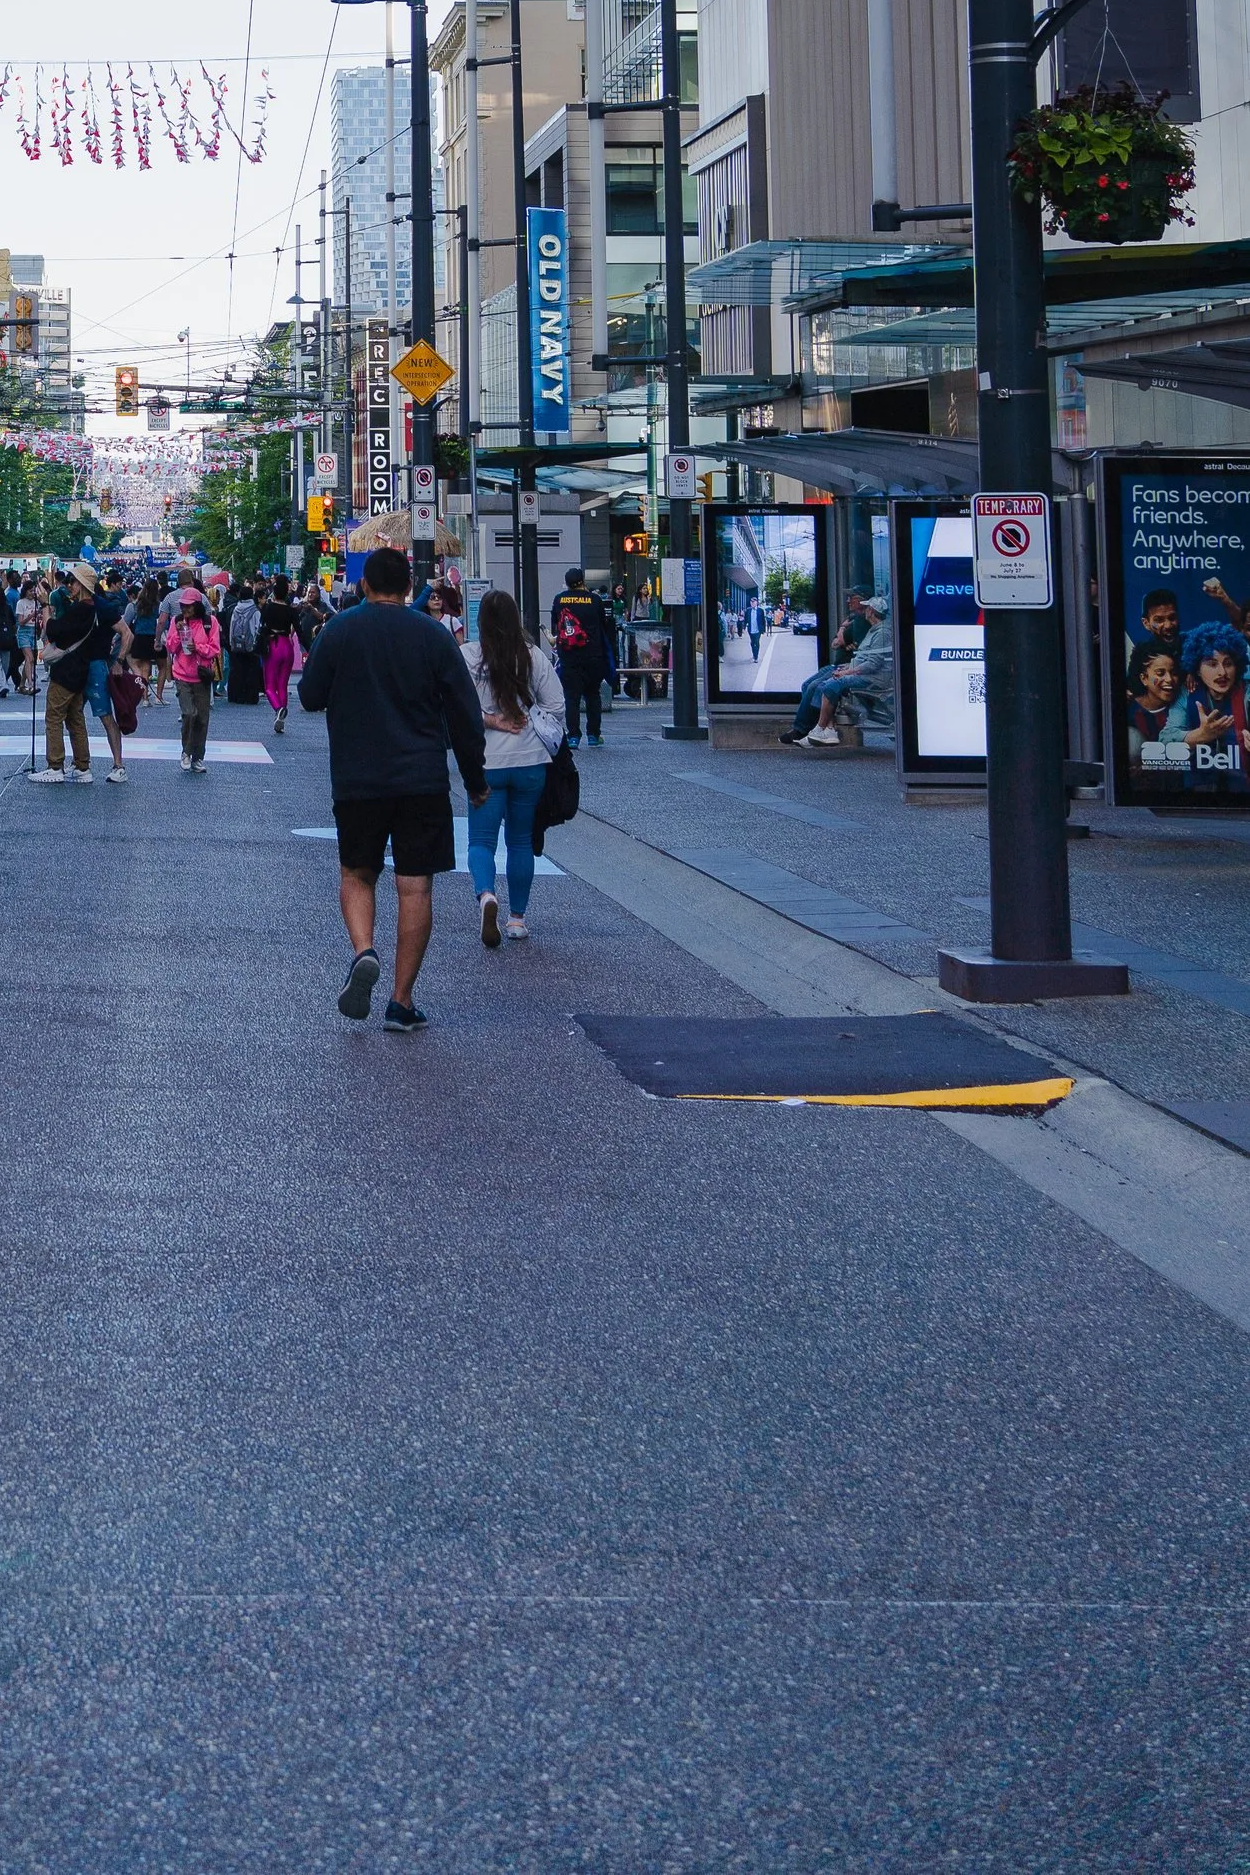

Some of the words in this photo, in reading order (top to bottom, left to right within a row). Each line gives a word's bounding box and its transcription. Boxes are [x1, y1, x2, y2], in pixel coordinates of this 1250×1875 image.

[538, 233, 562, 303] OLD
[411, 358, 433, 368] NEW
[540, 310, 564, 406] NAVY
[373, 344, 386, 402] REC
[1151, 378, 1178, 389] 9070
[373, 433, 387, 514] ROOM
[1132, 485, 1180, 503] Fans
[979, 499, 1041, 514] TEMPORARY
[1132, 506, 1208, 524] friends.
[1132, 529, 1245, 554] Anywhere,
[1133, 552, 1221, 574] anytime.
[940, 650, 984, 660] BUNDLE
[1141, 741, 1191, 761] 26
[1196, 744, 1241, 770] Bell
